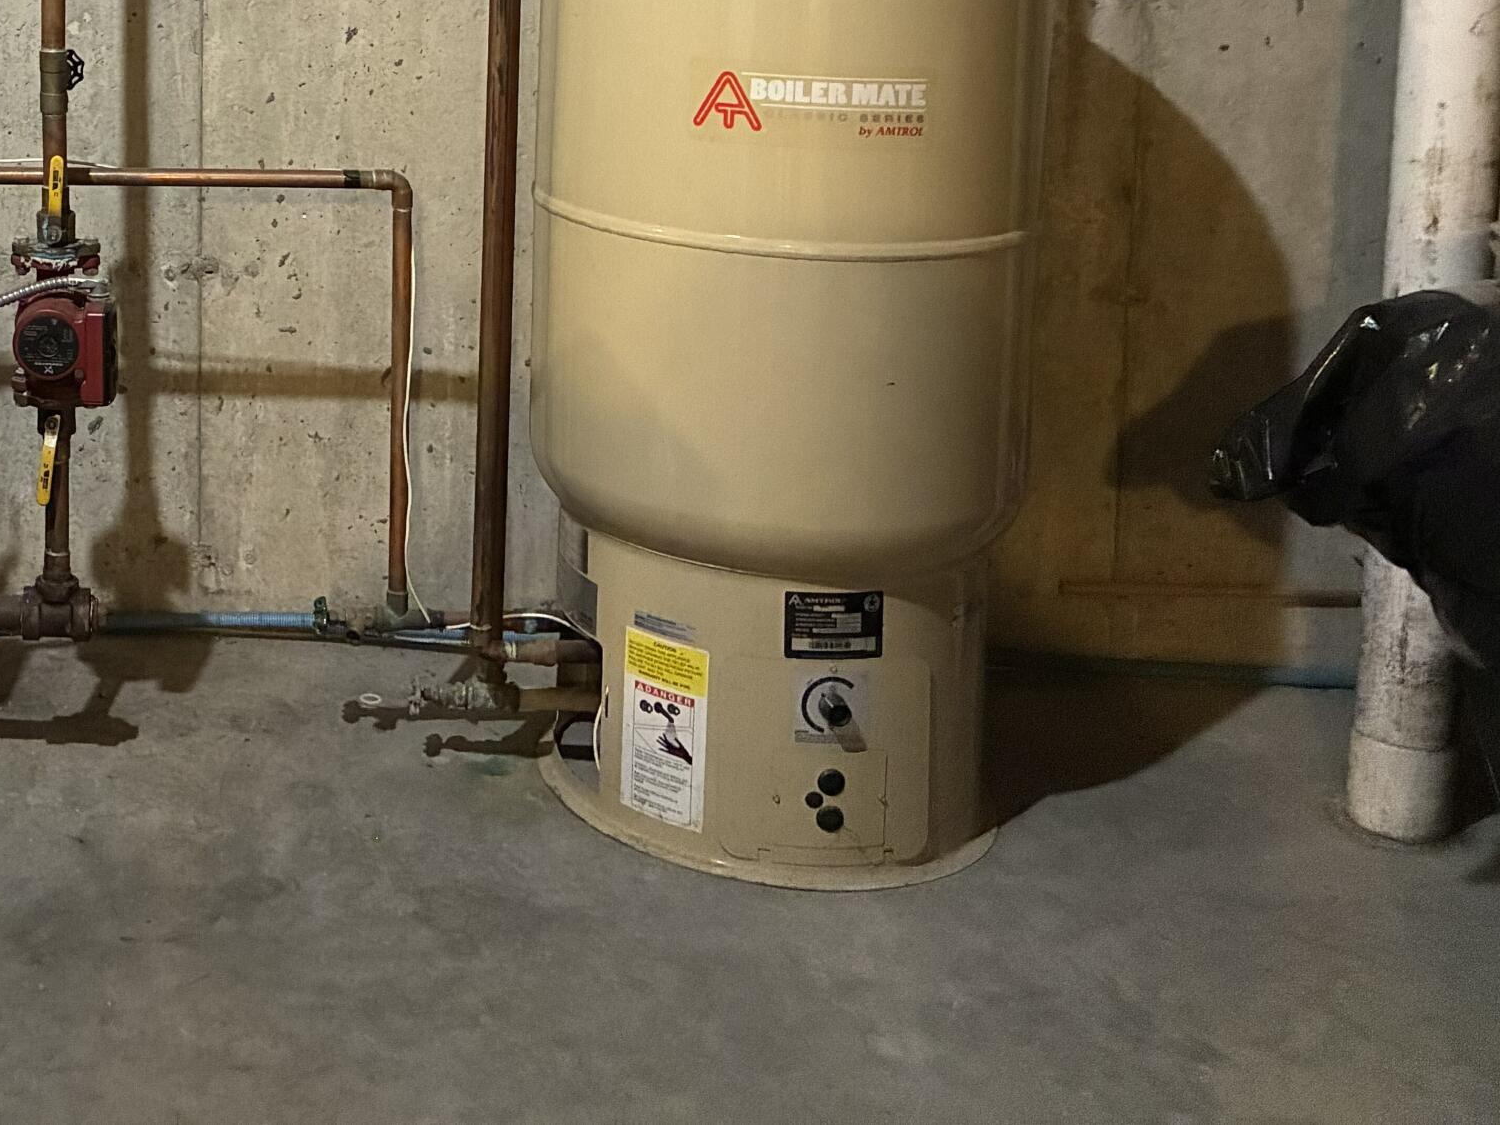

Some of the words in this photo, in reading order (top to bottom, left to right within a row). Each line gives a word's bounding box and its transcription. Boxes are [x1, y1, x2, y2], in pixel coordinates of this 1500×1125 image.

[749, 77, 848, 104] BOILER
[851, 82, 927, 107] MATE
[858, 112, 925, 124] SERIES
[858, 126, 873, 138] by
[876, 126, 924, 137] AMTROL
[644, 686, 692, 707] DANGER
